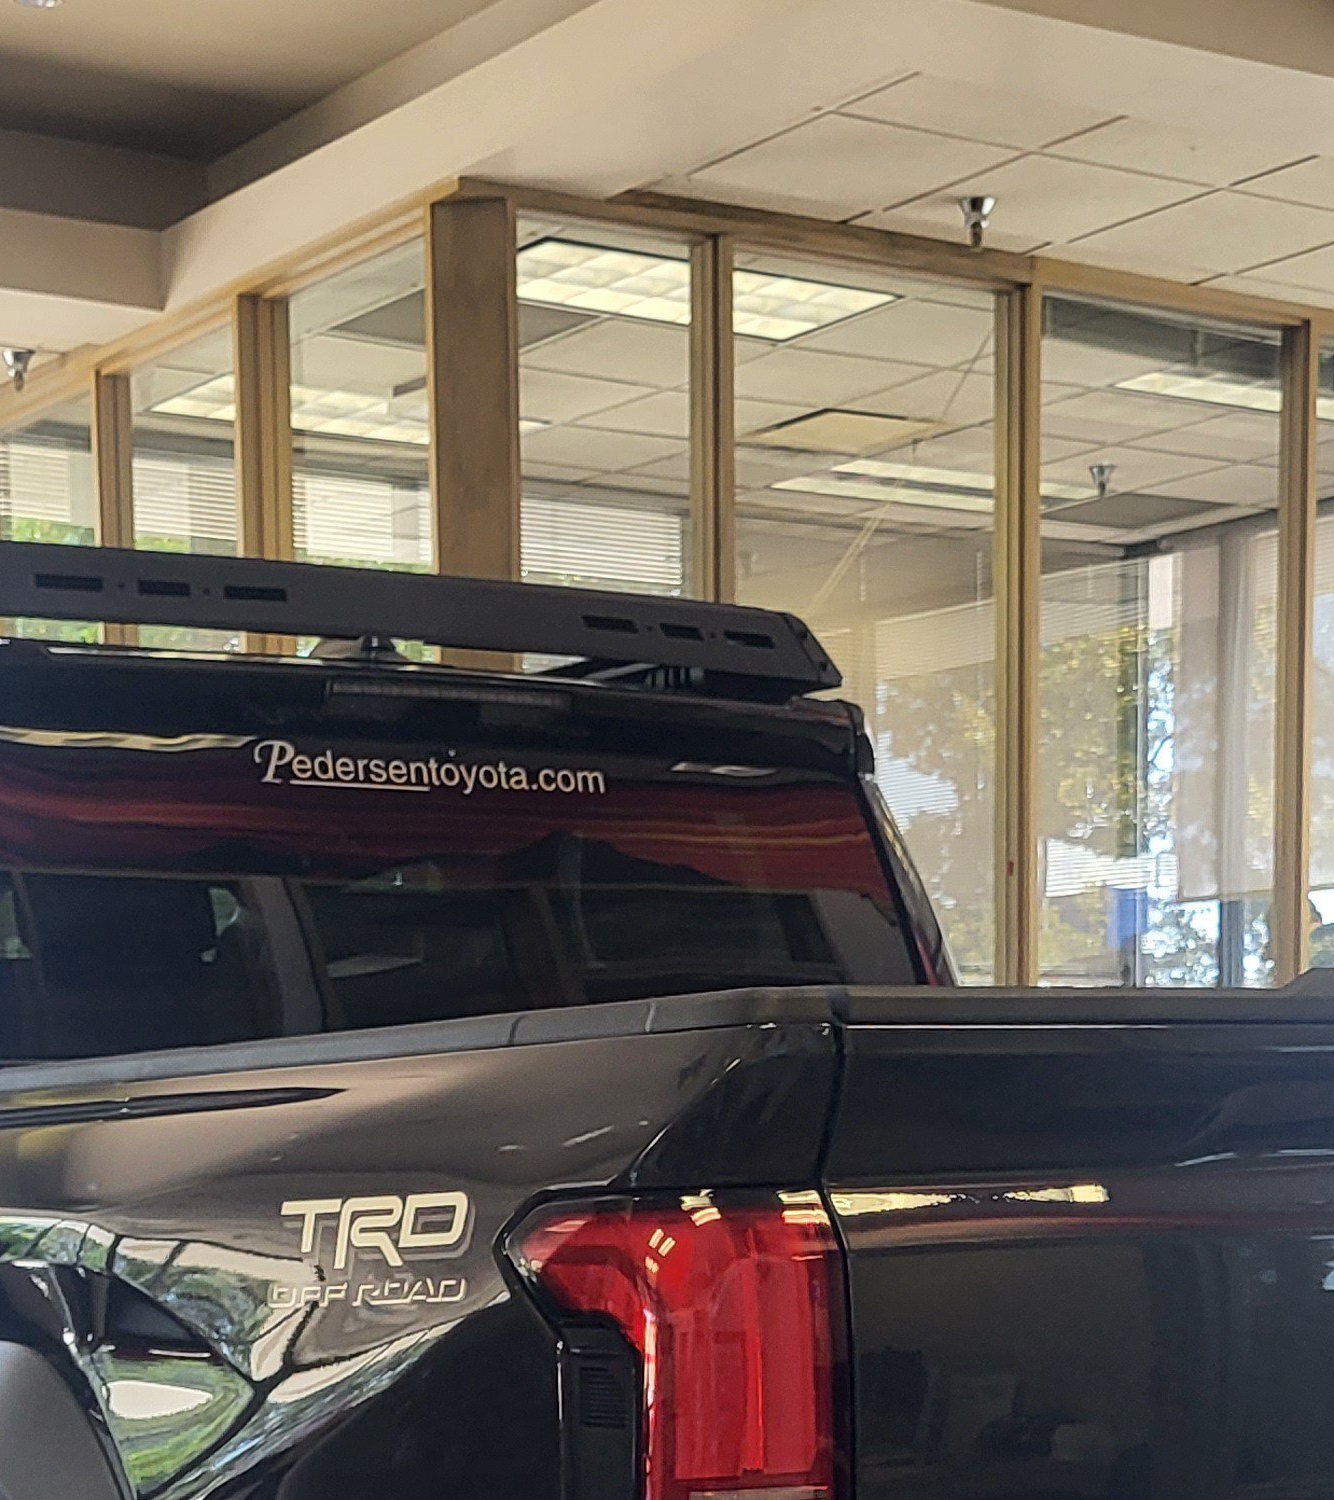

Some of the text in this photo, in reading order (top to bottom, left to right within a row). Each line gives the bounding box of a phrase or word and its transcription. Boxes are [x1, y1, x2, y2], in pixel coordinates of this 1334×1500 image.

[254, 740, 606, 795] Pedersentoyota.com
[280, 1192, 469, 1270] TRD
[269, 1277, 467, 1309] OFF ROAD
